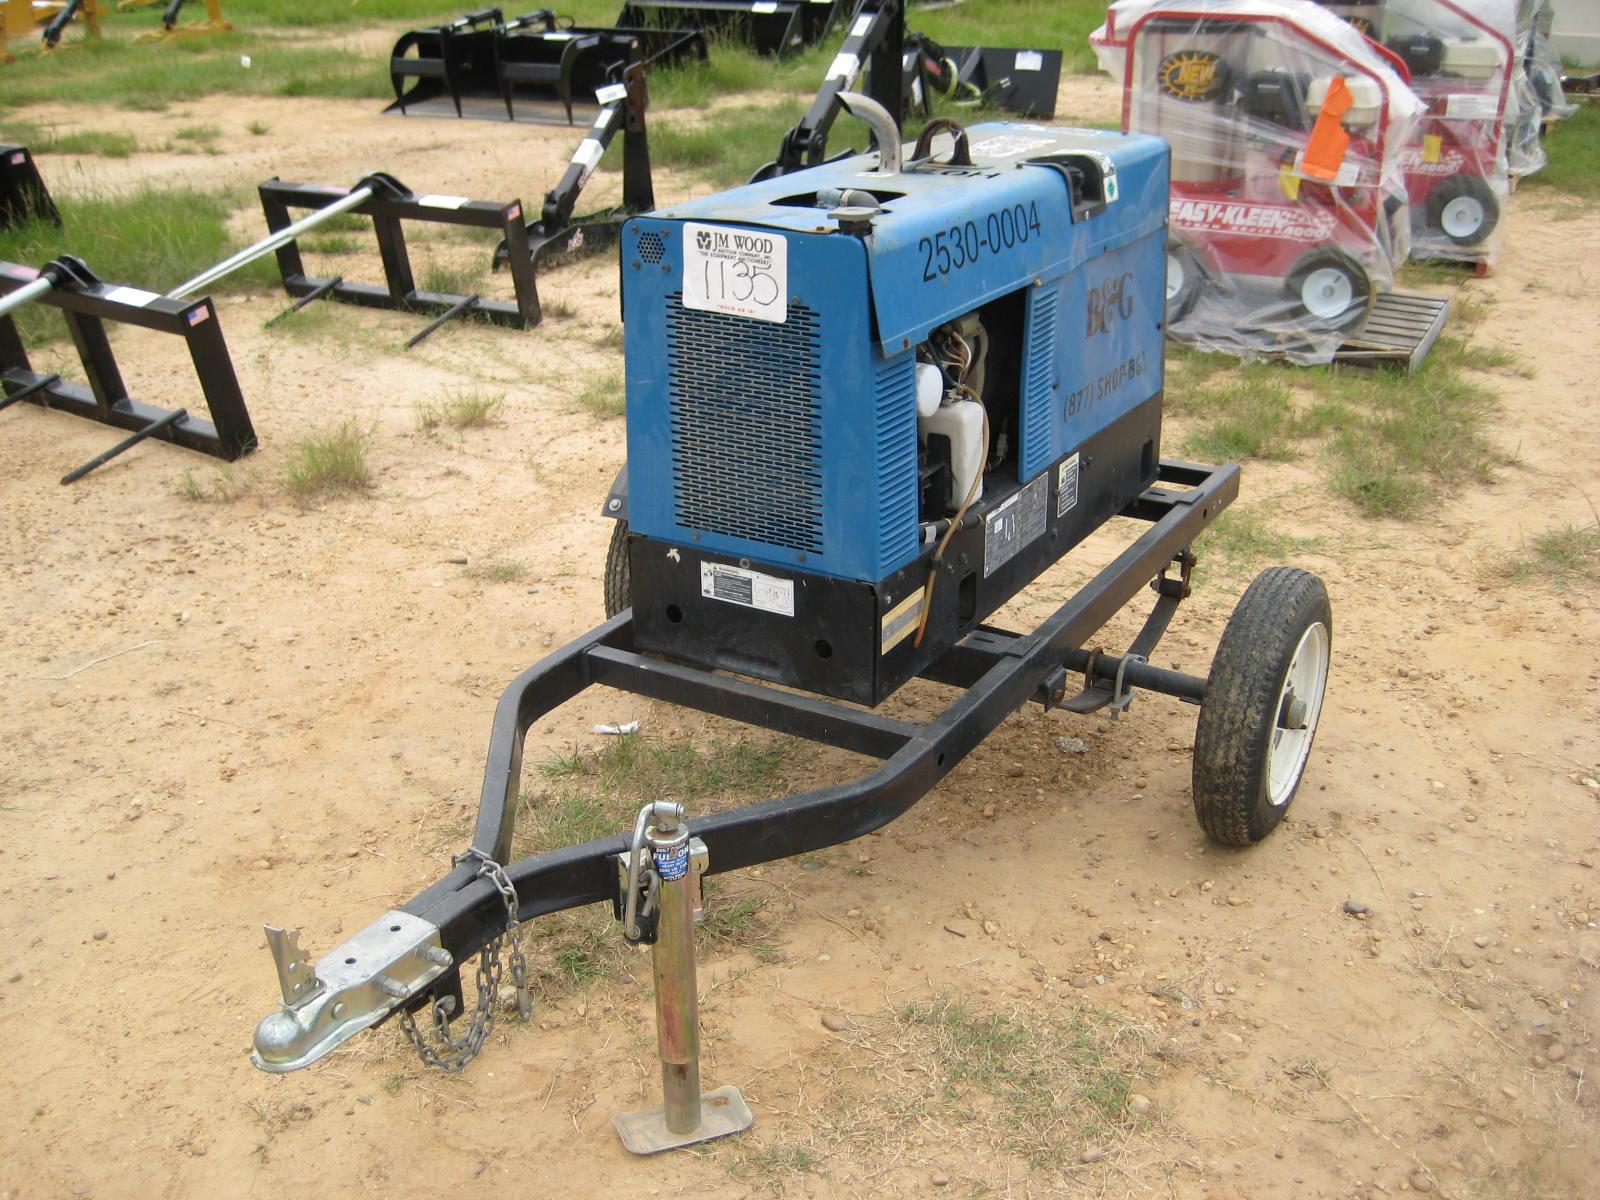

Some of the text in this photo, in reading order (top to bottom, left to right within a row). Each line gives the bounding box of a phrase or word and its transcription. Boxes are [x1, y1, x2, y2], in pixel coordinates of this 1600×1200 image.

[1178, 63, 1217, 83] NEW
[713, 232, 773, 254] JM WOOD
[918, 200, 1041, 283] 2530-0004
[704, 260, 779, 306] 1135
[1063, 383, 1094, 423] (877)
